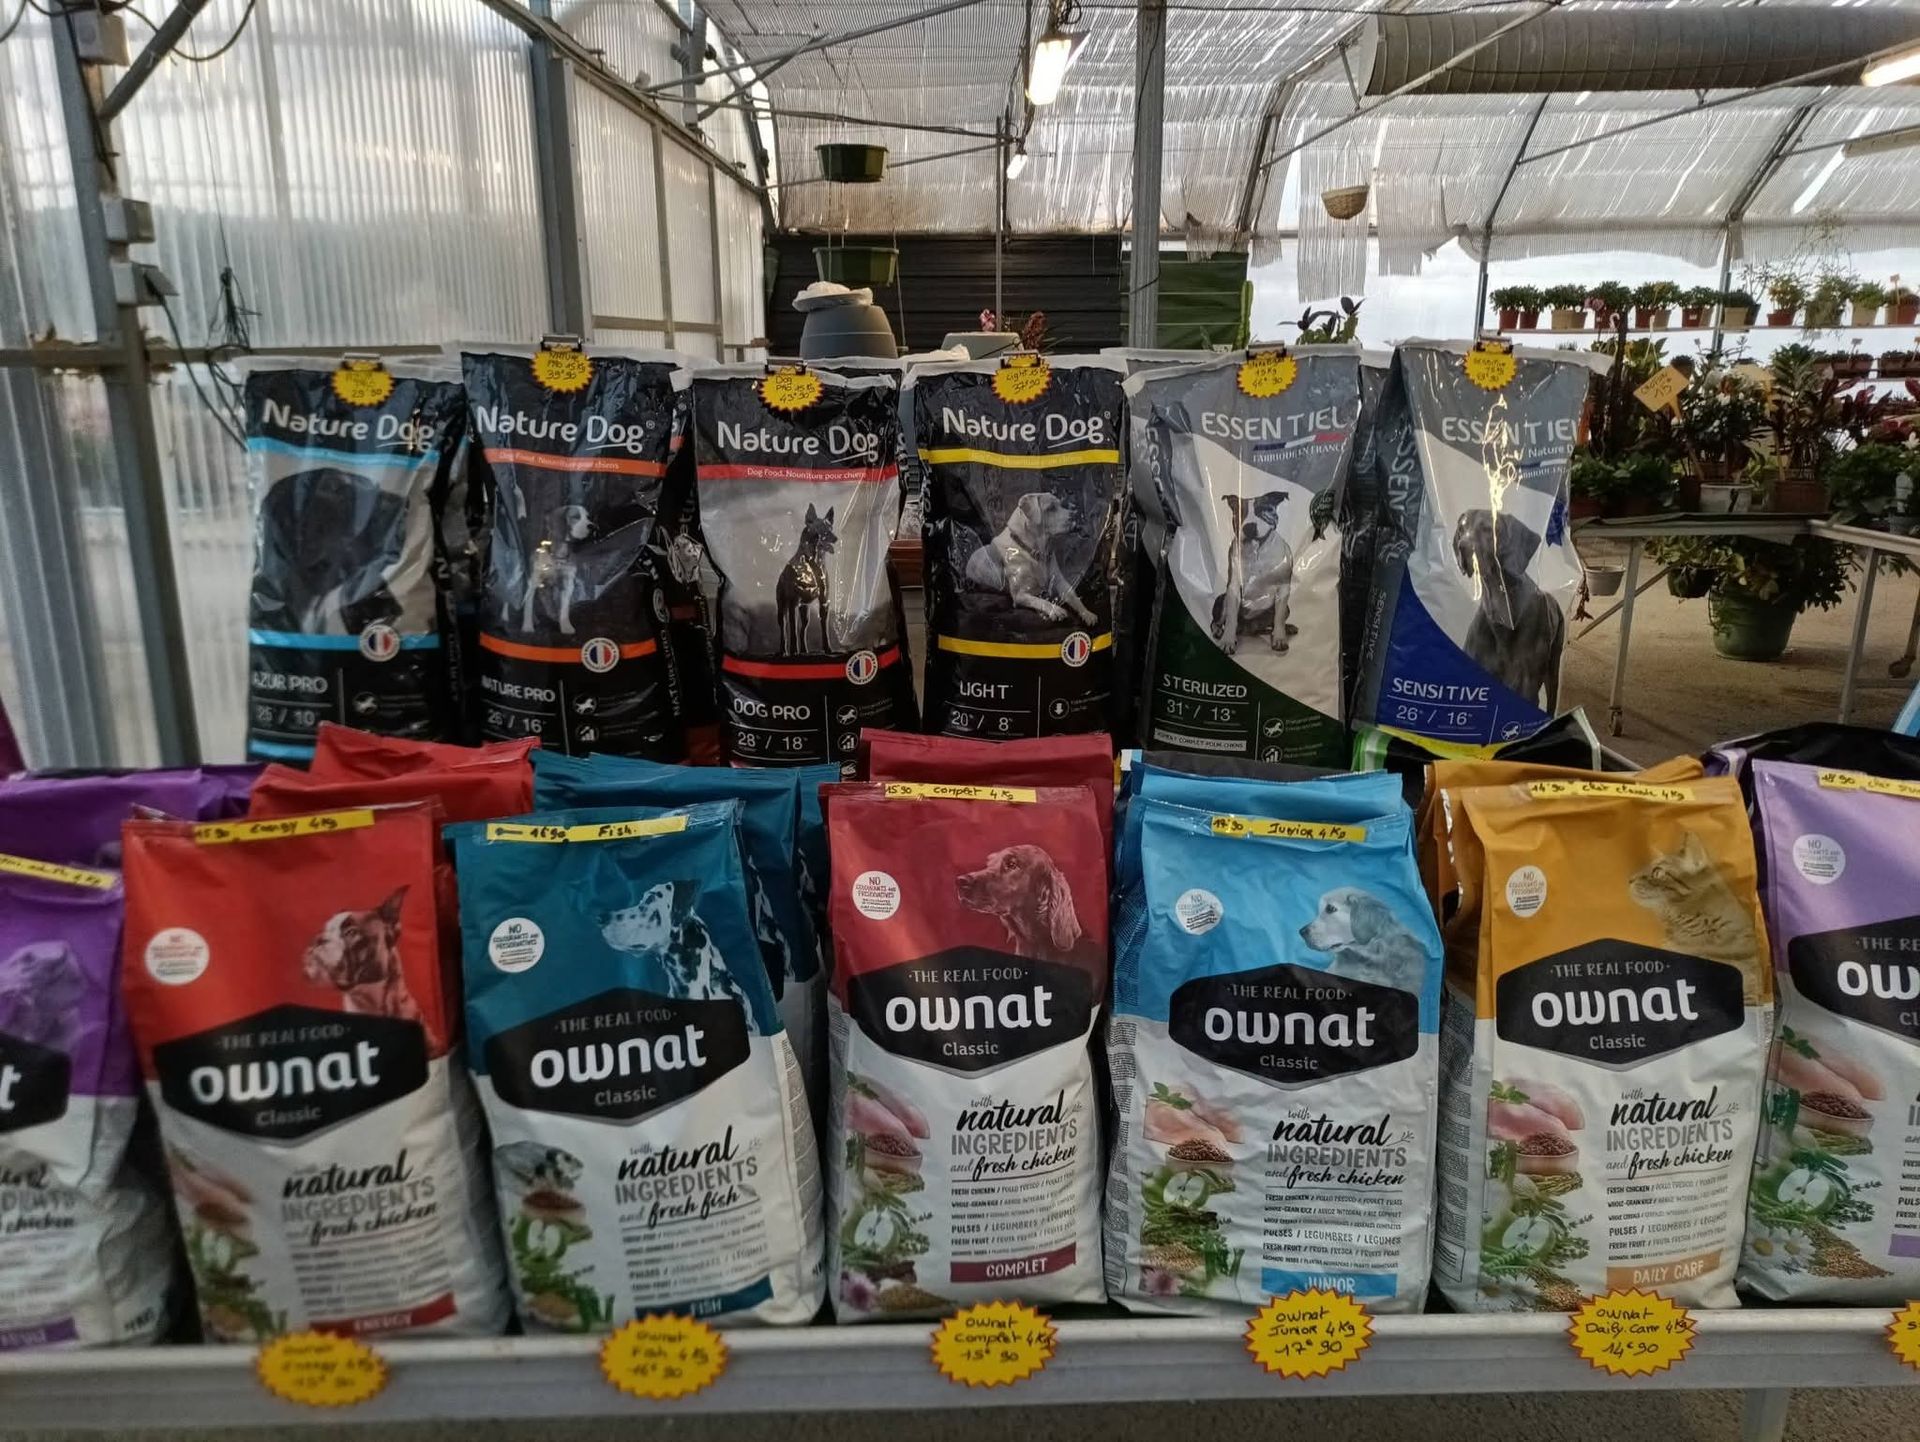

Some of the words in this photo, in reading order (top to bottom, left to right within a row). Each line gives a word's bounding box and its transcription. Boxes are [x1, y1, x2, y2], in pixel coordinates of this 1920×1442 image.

[262, 398, 369, 441] Nature
[376, 413, 435, 453] Dog
[476, 405, 578, 443] Nature
[586, 415, 644, 455] Dog
[942, 406, 1036, 442] Nature
[1045, 413, 1104, 449] Dog
[1201, 405, 1348, 441] ESSENTIEL
[717, 420, 820, 455] Nature
[828, 425, 879, 463] Dog
[747, 467, 763, 476] Dog
[289, 676, 328, 694] PRO
[524, 687, 556, 702] PRO
[960, 680, 1010, 700] LIGHT
[1163, 673, 1247, 698] STERILIZED
[1391, 677, 1490, 702] SENSITIVE
[772, 705, 811, 721] PRO
[990, 789, 998, 800] 4
[1319, 829, 1326, 839] 4
[869, 876, 881, 886] NO
[508, 923, 522, 934] NO
[1860, 936, 1893, 950] THE
[912, 969, 938, 983] THE
[944, 968, 979, 983] REAL
[983, 967, 1023, 980] FOOD
[1555, 964, 1583, 978] THE
[1587, 962, 1622, 976] REAL
[1626, 960, 1664, 974] FOOD
[1231, 984, 1259, 998] THE
[1263, 985, 1300, 1000] REAL
[1305, 987, 1347, 1001] FOOD
[1531, 978, 1699, 1028] ownat
[885, 985, 1053, 1032] ownat
[300, 1024, 344, 1040] FOOD
[560, 1018, 591, 1034] THE
[594, 1012, 634, 1029] REAL
[637, 1008, 672, 1024] FOOD
[1204, 1006, 1376, 1048] ownat
[943, 1041, 999, 1056] Classic
[1589, 1033, 1646, 1050] Classic
[530, 1023, 707, 1088] ownat
[1260, 1054, 1320, 1070] Classic
[190, 1040, 381, 1104] ownat
[594, 1083, 658, 1107] Classic
[1609, 1085, 1718, 1126] natural
[255, 1105, 322, 1127] Classic
[956, 1089, 1066, 1132] natural
[951, 1118, 1077, 1155] INGREDIENTS
[1272, 1113, 1393, 1147] natural
[1606, 1117, 1733, 1152] INGREDIENTS
[618, 1124, 740, 1181] natural
[951, 1158, 974, 1173] and
[972, 1153, 1018, 1182] fresh
[1021, 1145, 1076, 1171] chicken
[1267, 1143, 1408, 1169] INGREDIENTS
[1606, 1154, 1629, 1170] and
[1628, 1150, 1670, 1180] fresh
[1673, 1143, 1734, 1167] chicken
[283, 1148, 414, 1198] natural
[615, 1156, 758, 1205] INGREDIENTS
[1287, 1165, 1335, 1189] fresh
[1337, 1167, 1406, 1186] chicken
[282, 1175, 436, 1222] INGREDIENTS
[648, 1197, 699, 1229] fresh
[700, 1184, 741, 1220] fish
[951, 1224, 981, 1234] PULSES
[1263, 1228, 1293, 1238] PULSES
[1304, 1230, 1353, 1243] LEGUMBRES
[1609, 1226, 1638, 1237] PULSES
[1648, 1220, 1692, 1233] LEGUMBRES
[986, 1257, 1047, 1278] COMPLET
[1633, 1267, 1670, 1284] DAILY
[1303, 1276, 1356, 1293] JUNIOR
[1026, 1330, 1033, 1347] 4
[1325, 1321, 1335, 1337] 4
[1339, 1320, 1356, 1337] Kg
[1665, 1320, 1671, 1334] 4
